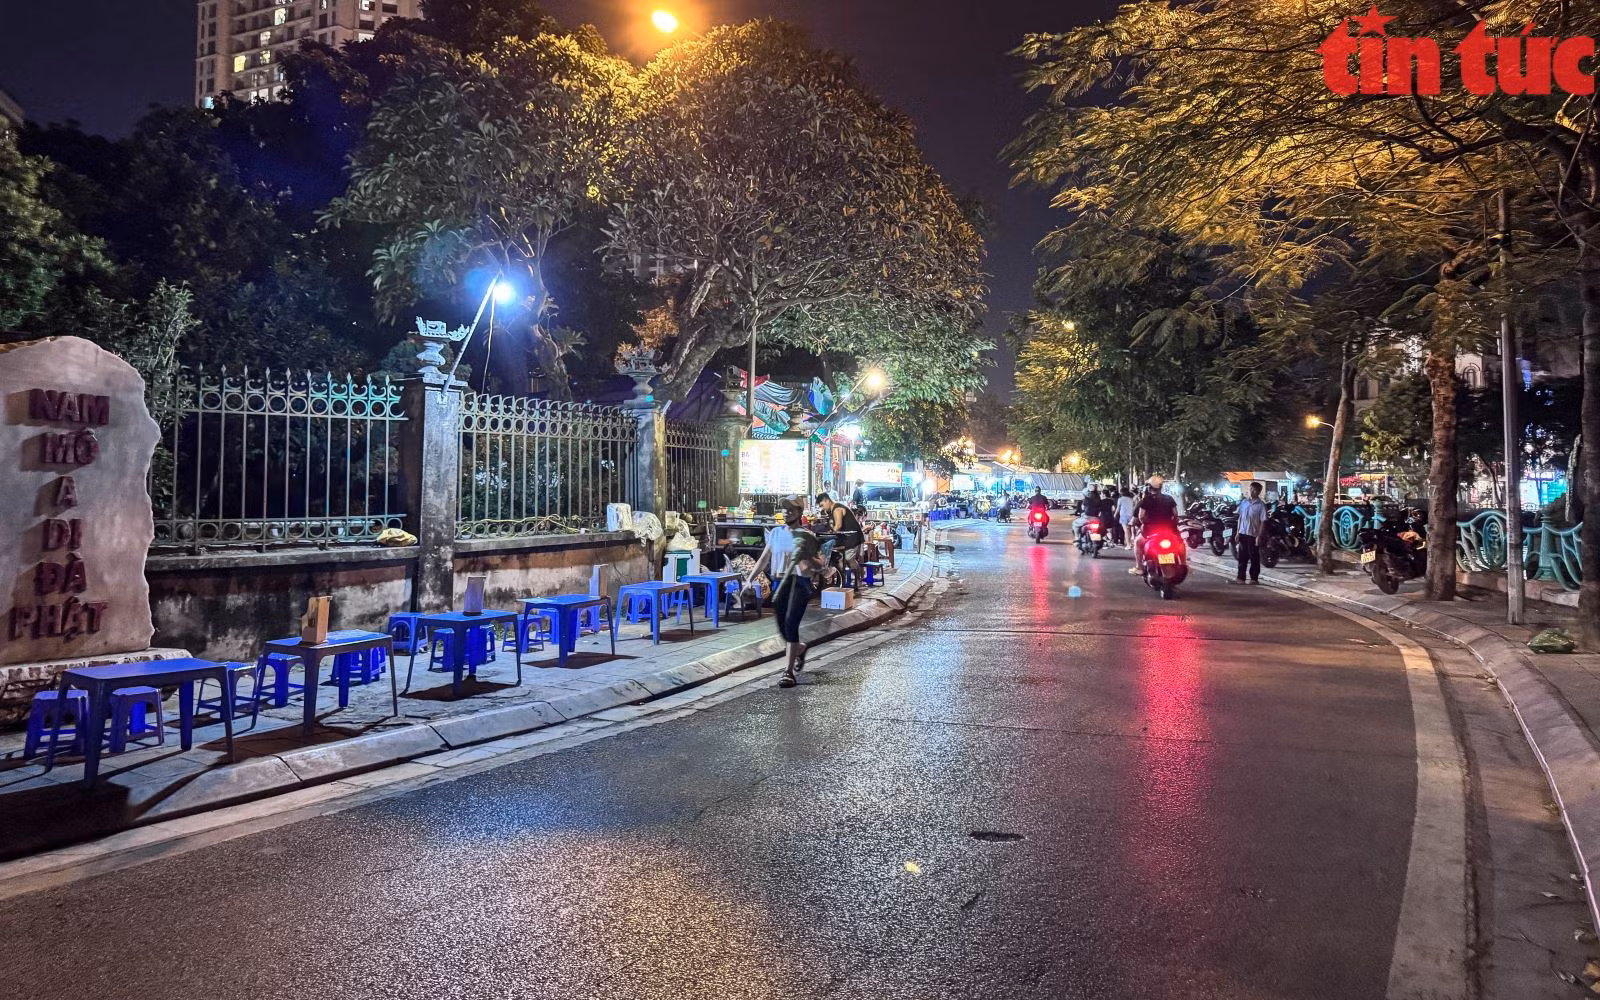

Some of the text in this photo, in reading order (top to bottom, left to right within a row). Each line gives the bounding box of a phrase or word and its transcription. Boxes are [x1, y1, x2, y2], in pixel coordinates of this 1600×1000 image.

[29, 388, 110, 426] NAM
[41, 428, 99, 465] MÔ
[54, 476, 79, 508] A
[42, 518, 82, 552] DI
[34, 552, 87, 596] ĐÀ
[8, 596, 109, 643] PHẬT
